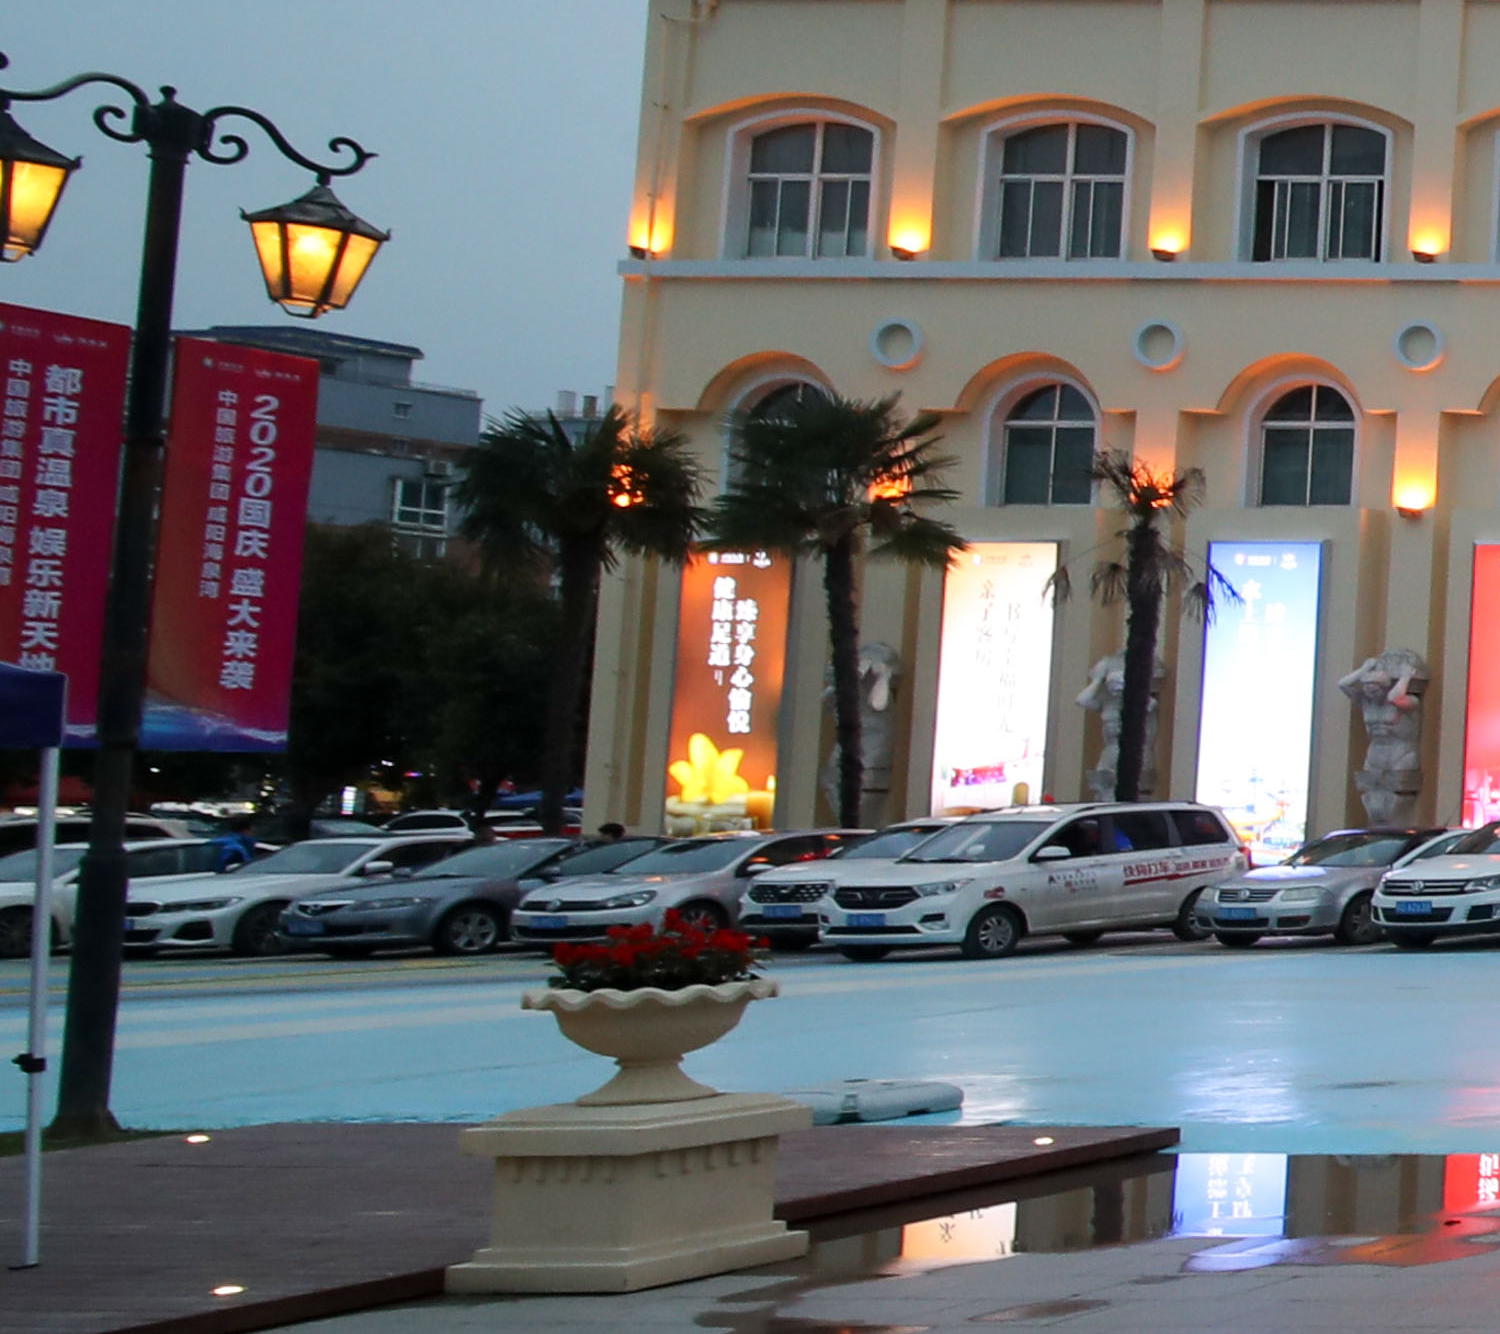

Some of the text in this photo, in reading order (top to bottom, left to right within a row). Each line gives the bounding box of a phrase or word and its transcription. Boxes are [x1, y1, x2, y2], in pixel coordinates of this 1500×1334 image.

[33, 364, 84, 520] 都市真温泉
[234, 394, 280, 560] 2020国庆
[219, 567, 265, 691] 盛大来袭
